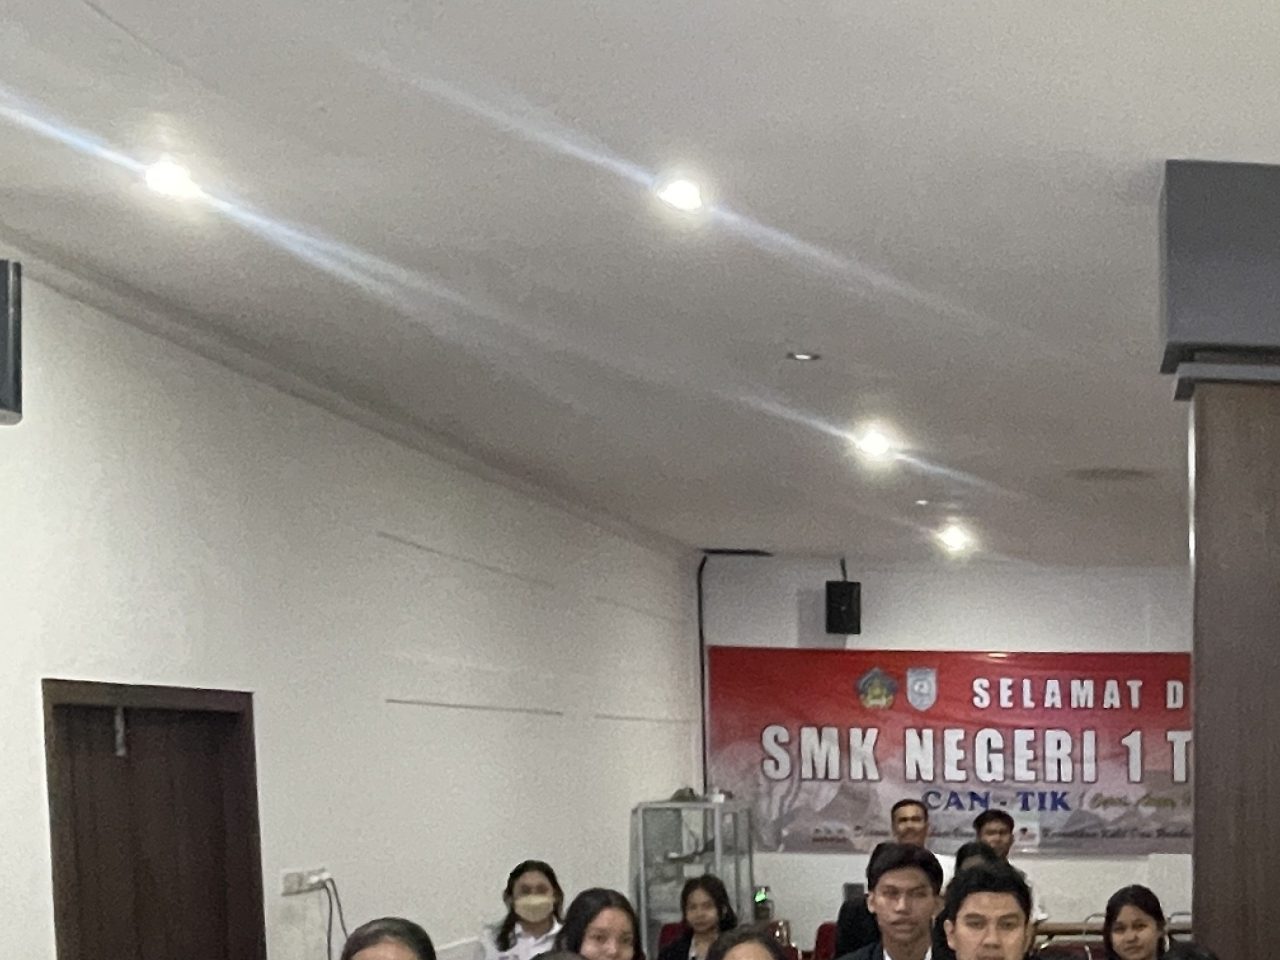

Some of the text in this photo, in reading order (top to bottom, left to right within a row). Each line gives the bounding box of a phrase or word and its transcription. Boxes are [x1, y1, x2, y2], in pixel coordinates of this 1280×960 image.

[973, 679, 1143, 708] SELAMAT
[762, 725, 880, 780] SMK
[905, 728, 1096, 783] NEGERI
[1121, 730, 1142, 782] 1
[921, 790, 991, 810] CAN
[1016, 791, 1072, 811] TIK
